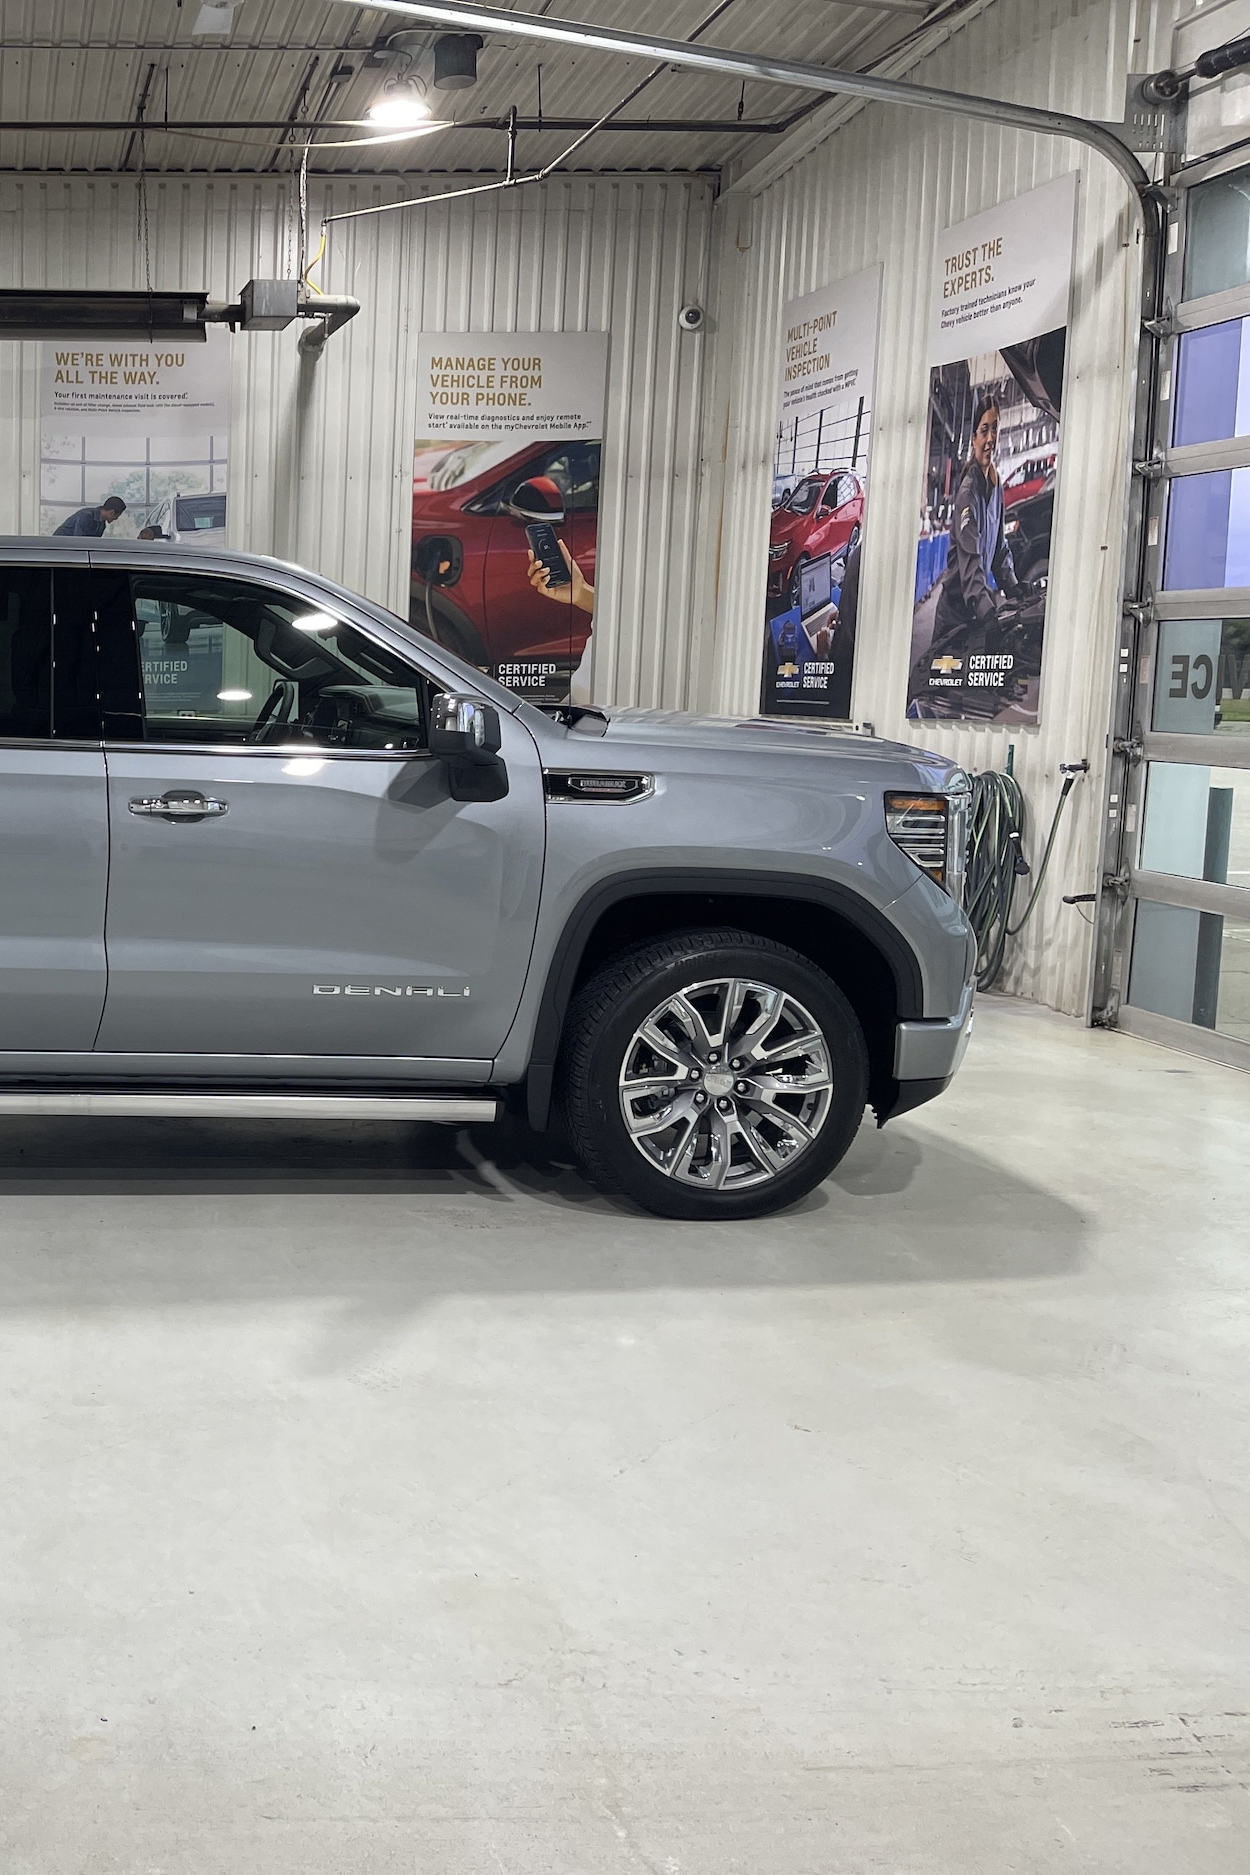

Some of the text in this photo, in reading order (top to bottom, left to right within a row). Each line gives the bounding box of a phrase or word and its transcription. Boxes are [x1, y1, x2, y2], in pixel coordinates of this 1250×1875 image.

[944, 237, 1003, 277] TRUST THE
[943, 265, 995, 299] EXPERTS.
[941, 306, 960, 318] Factory
[960, 298, 978, 313] trained
[1007, 284, 1022, 296] know
[1022, 278, 1036, 293] your
[940, 316, 955, 329] Chevy
[955, 312, 973, 324] vehicle
[973, 306, 989, 319] better
[989, 303, 1002, 314] than
[787, 310, 838, 344] MULTI-POINT
[786, 337, 818, 363] VEHICLE
[109, 353, 150, 367] WITH
[154, 353, 185, 368] YOU
[431, 356, 542, 371] MANAGE YOUR
[784, 353, 831, 382] INSPECTION
[54, 370, 160, 386] ALL THE WAY.
[430, 374, 543, 389] VEHICLE FROM
[54, 391, 70, 399] Your
[71, 391, 87, 399] first
[88, 392, 133, 400] maintenance
[134, 392, 150, 400] visit
[150, 392, 157, 400] is
[429, 391, 532, 407] YOUR PHONE.
[428, 412, 582, 423] View real-time diagnostics and enjoy remote
[449, 421, 480, 430] available
[491, 422, 503, 430] the
[504, 422, 548, 431] myChevrolet
[549, 421, 572, 430] Mobile
[498, 663, 557, 675] CERTIFIED
[803, 662, 835, 675] CERTIFIED
[969, 655, 1014, 670] CERTIFIED
[498, 676, 546, 687] SERVICE
[802, 676, 829, 689] SERVICE
[968, 672, 1005, 687] SERVICE
[313, 984, 471, 997] DENALI
